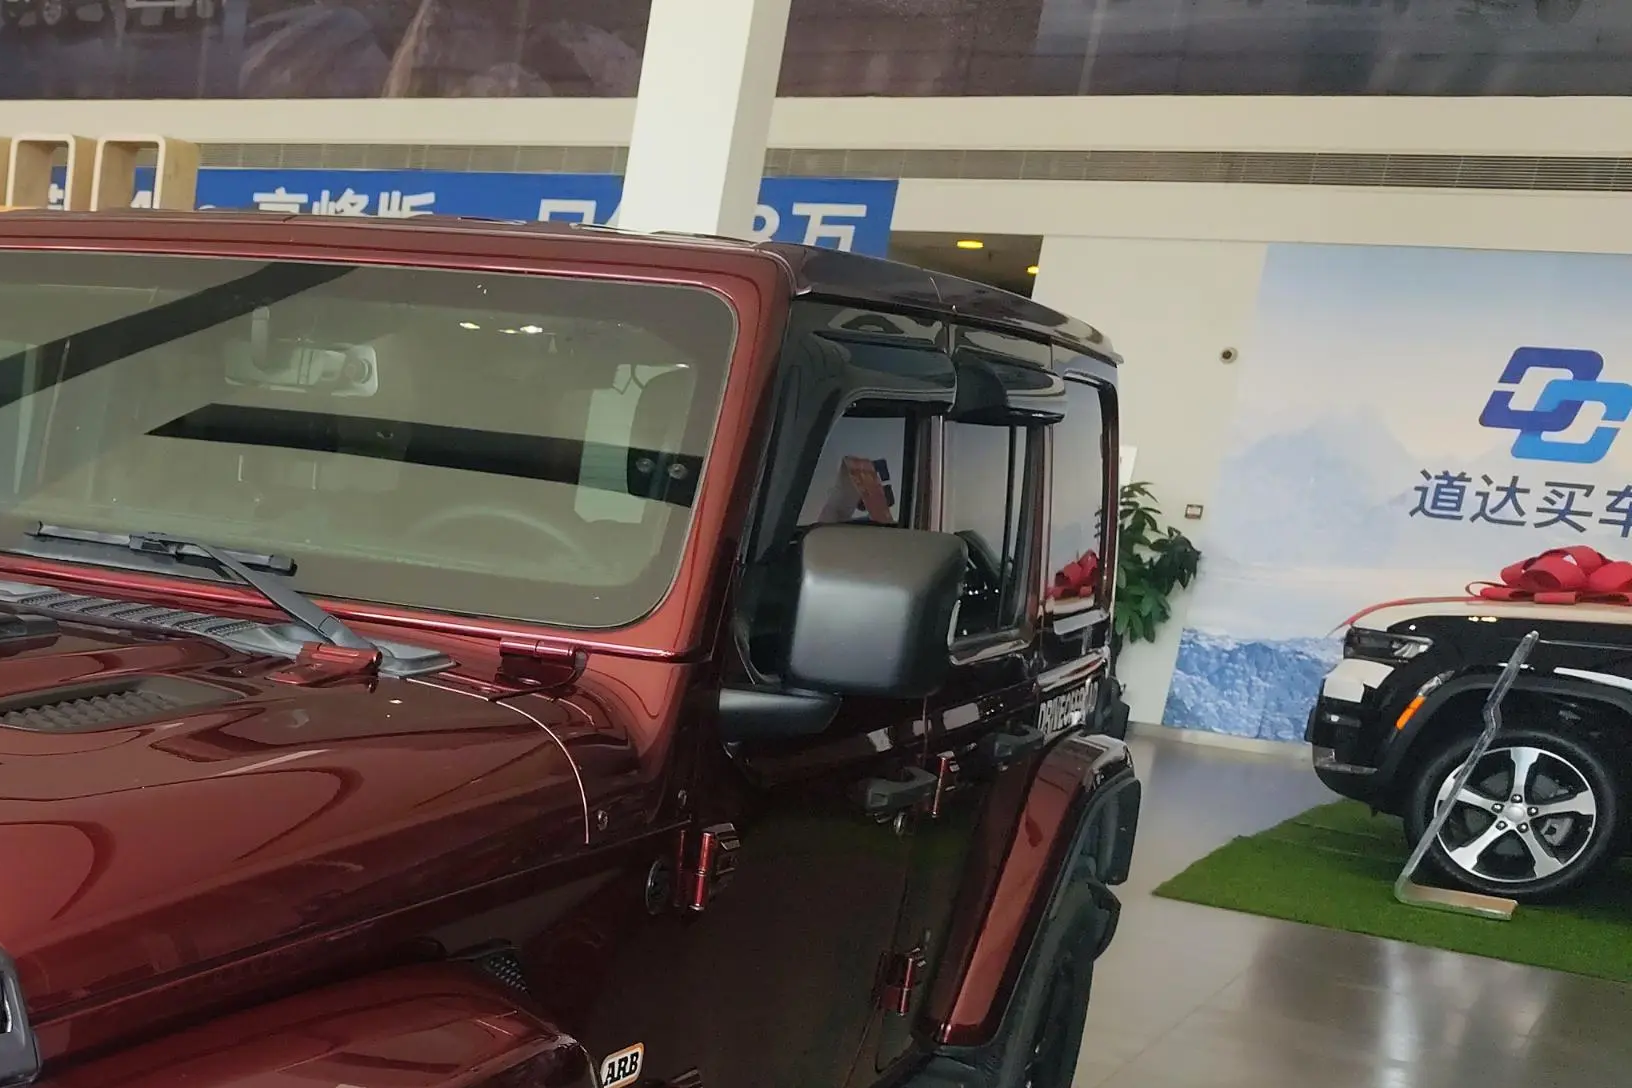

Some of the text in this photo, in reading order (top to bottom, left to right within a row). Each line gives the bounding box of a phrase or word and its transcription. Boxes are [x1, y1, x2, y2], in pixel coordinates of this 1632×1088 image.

[1409, 468, 1632, 537] 道达买车
[604, 1051, 639, 1087] ARB
